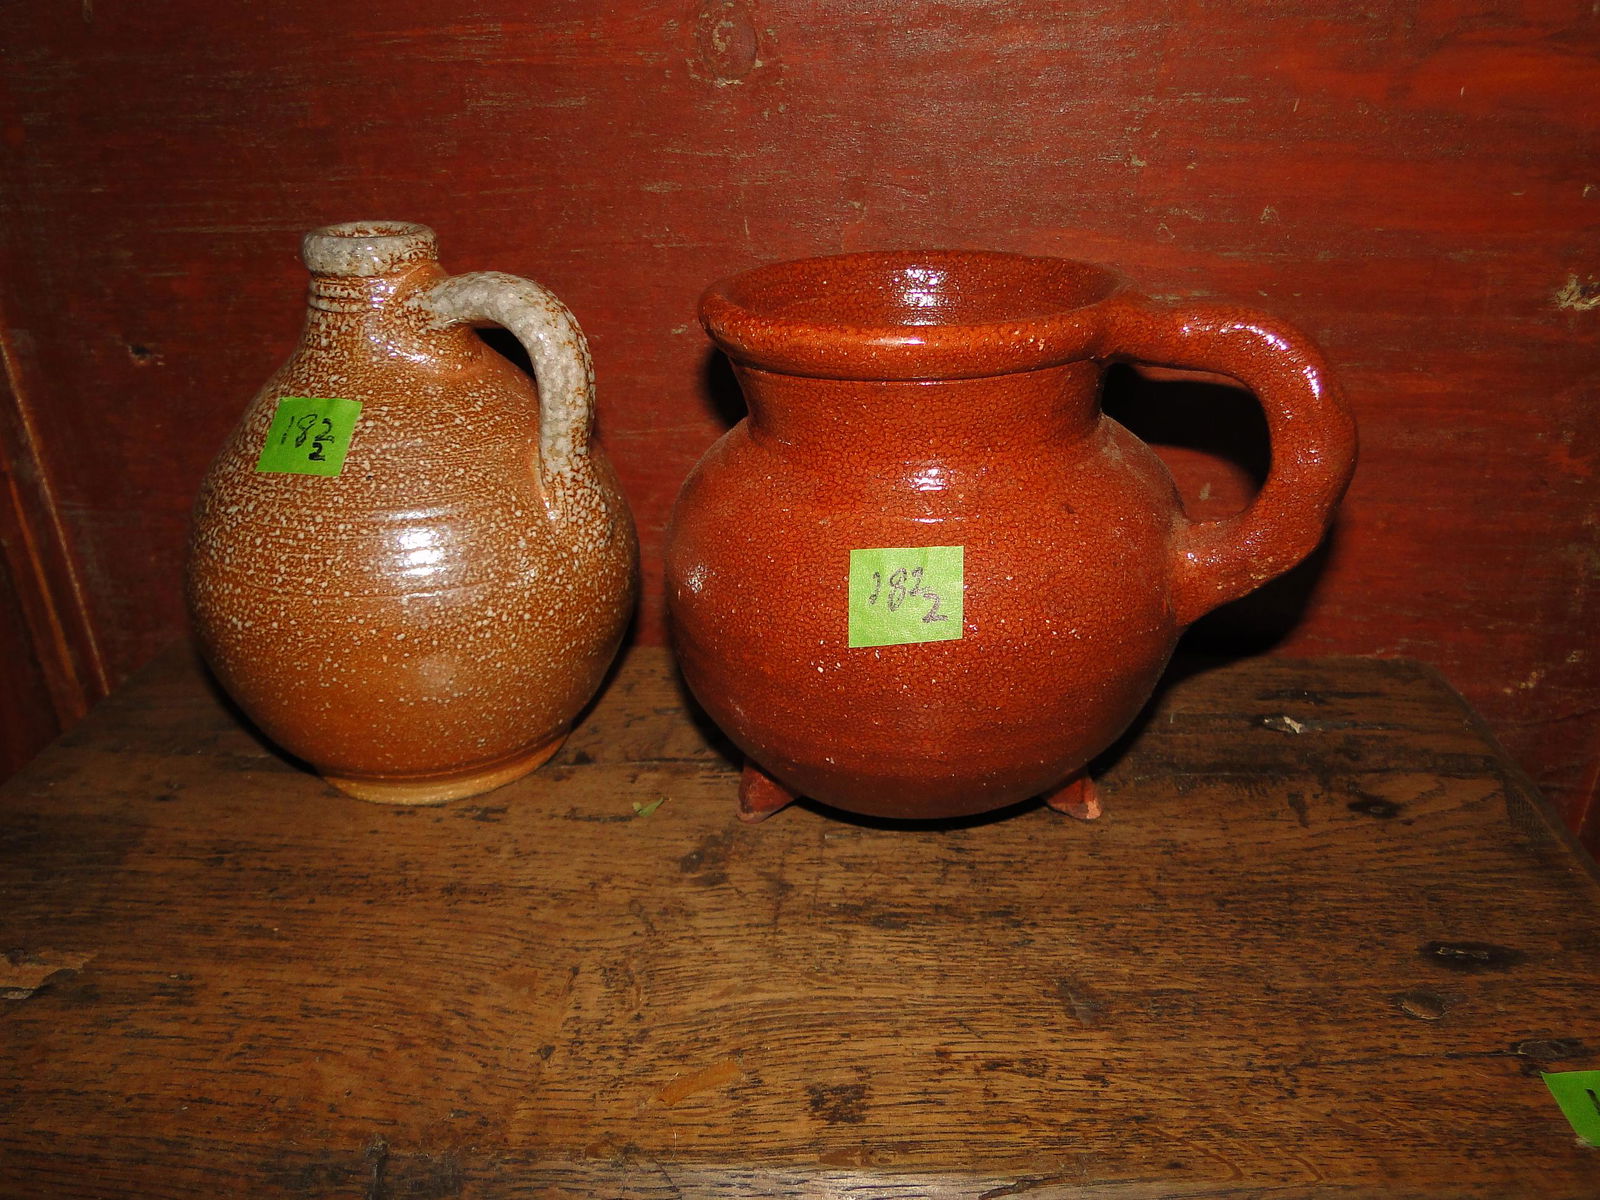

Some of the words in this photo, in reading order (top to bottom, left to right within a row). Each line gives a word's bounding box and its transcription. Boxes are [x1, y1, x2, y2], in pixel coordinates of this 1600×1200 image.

[280, 413, 335, 449] 182
[308, 441, 326, 462] 2
[868, 566, 932, 612] 182
[922, 592, 949, 623] 2
